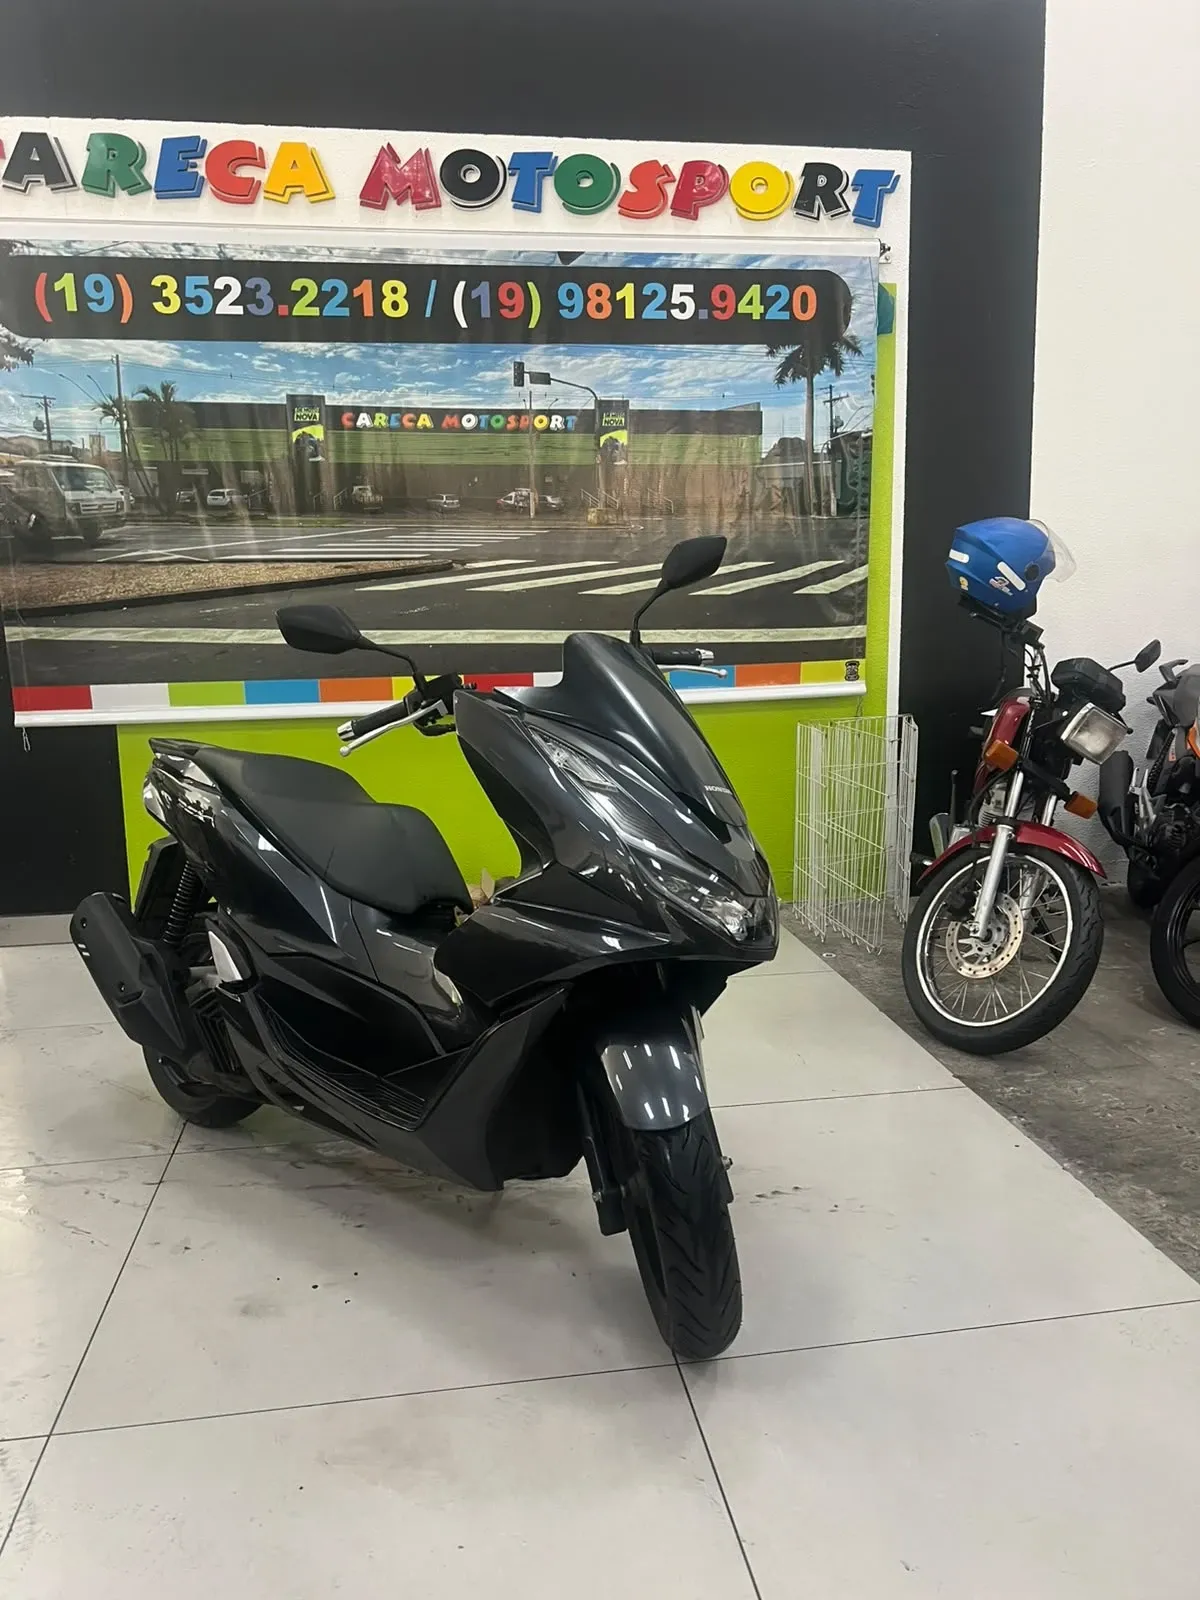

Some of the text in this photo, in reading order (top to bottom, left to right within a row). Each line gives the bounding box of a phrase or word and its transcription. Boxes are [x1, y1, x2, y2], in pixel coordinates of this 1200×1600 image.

[0, 131, 901, 228] ARECA MOTOSPORT
[35, 272, 817, 329] (19) 3523.2218 / (19) 98125.9420
[295, 413, 317, 421] NOVA
[341, 412, 578, 432] CARECA MOTOSPORT
[603, 417, 623, 426] NOVA
